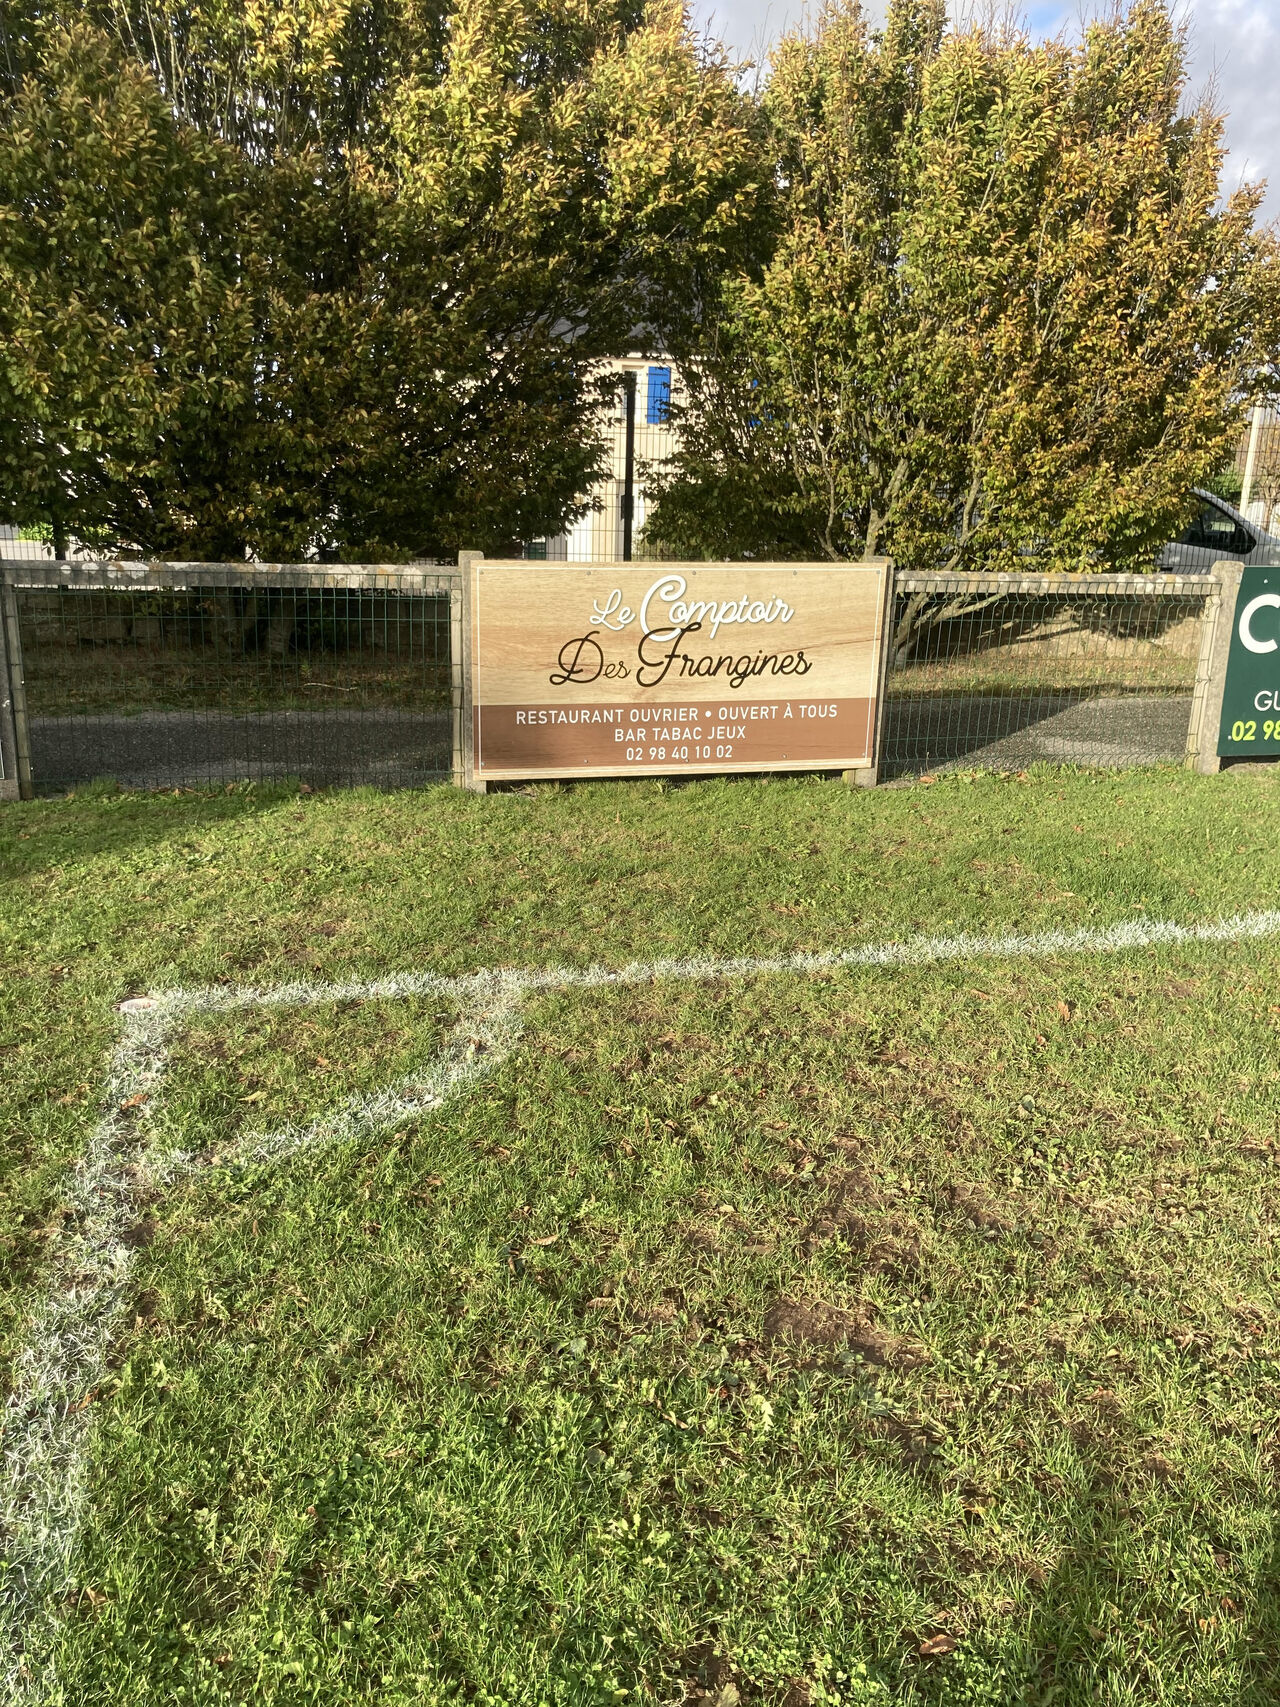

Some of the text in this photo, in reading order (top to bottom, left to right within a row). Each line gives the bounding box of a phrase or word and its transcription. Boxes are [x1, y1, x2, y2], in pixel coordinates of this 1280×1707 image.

[589, 574, 794, 642] Le Comptoir
[549, 622, 813, 688] Des Frangines
[516, 703, 837, 725] RESTAURANT OUVRIER OUVERT À TOUS
[614, 726, 746, 742] BAR TABAC JEUX
[1231, 721, 1257, 741] 02
[626, 745, 732, 760] 02 98 40 10 02
